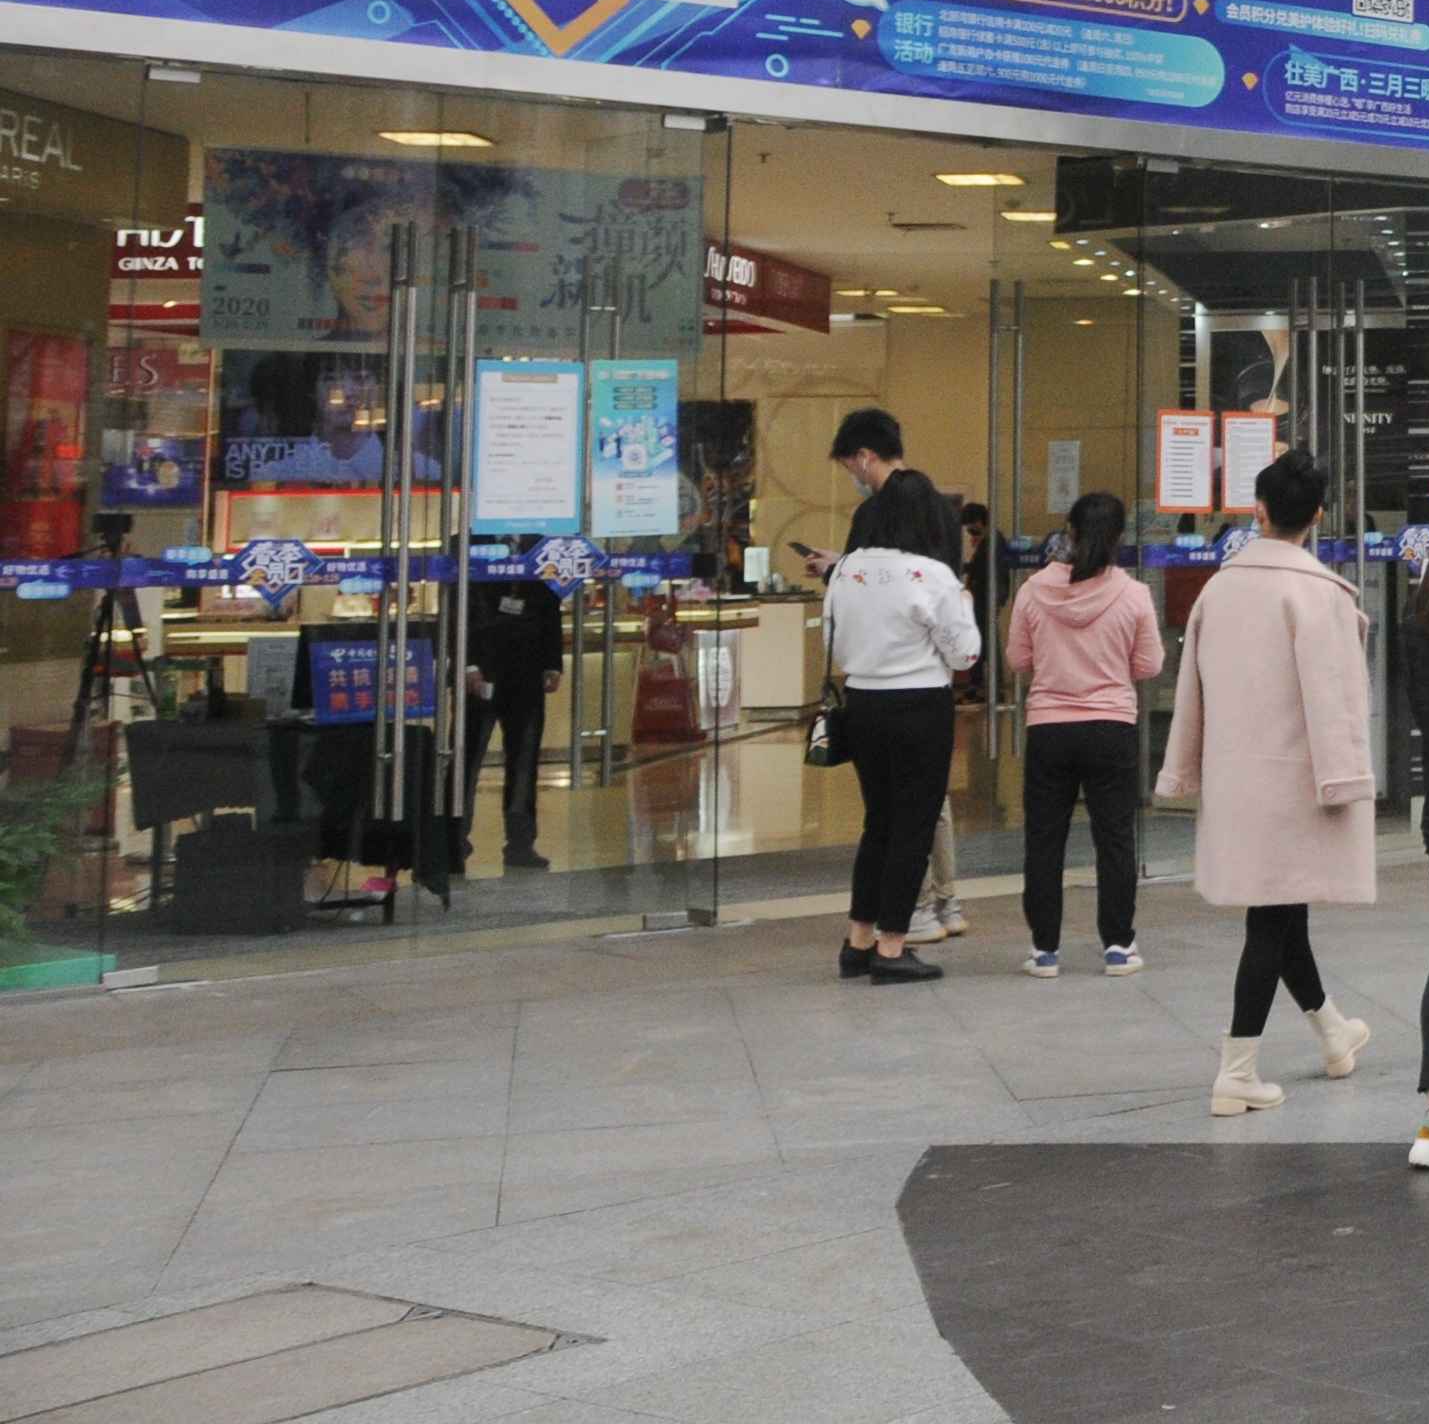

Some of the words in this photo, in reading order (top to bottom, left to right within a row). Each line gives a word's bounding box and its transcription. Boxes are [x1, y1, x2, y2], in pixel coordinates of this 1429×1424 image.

[895, 12, 934, 37] 银行
[894, 39, 934, 65] 活动
[118, 256, 179, 271] GINZA
